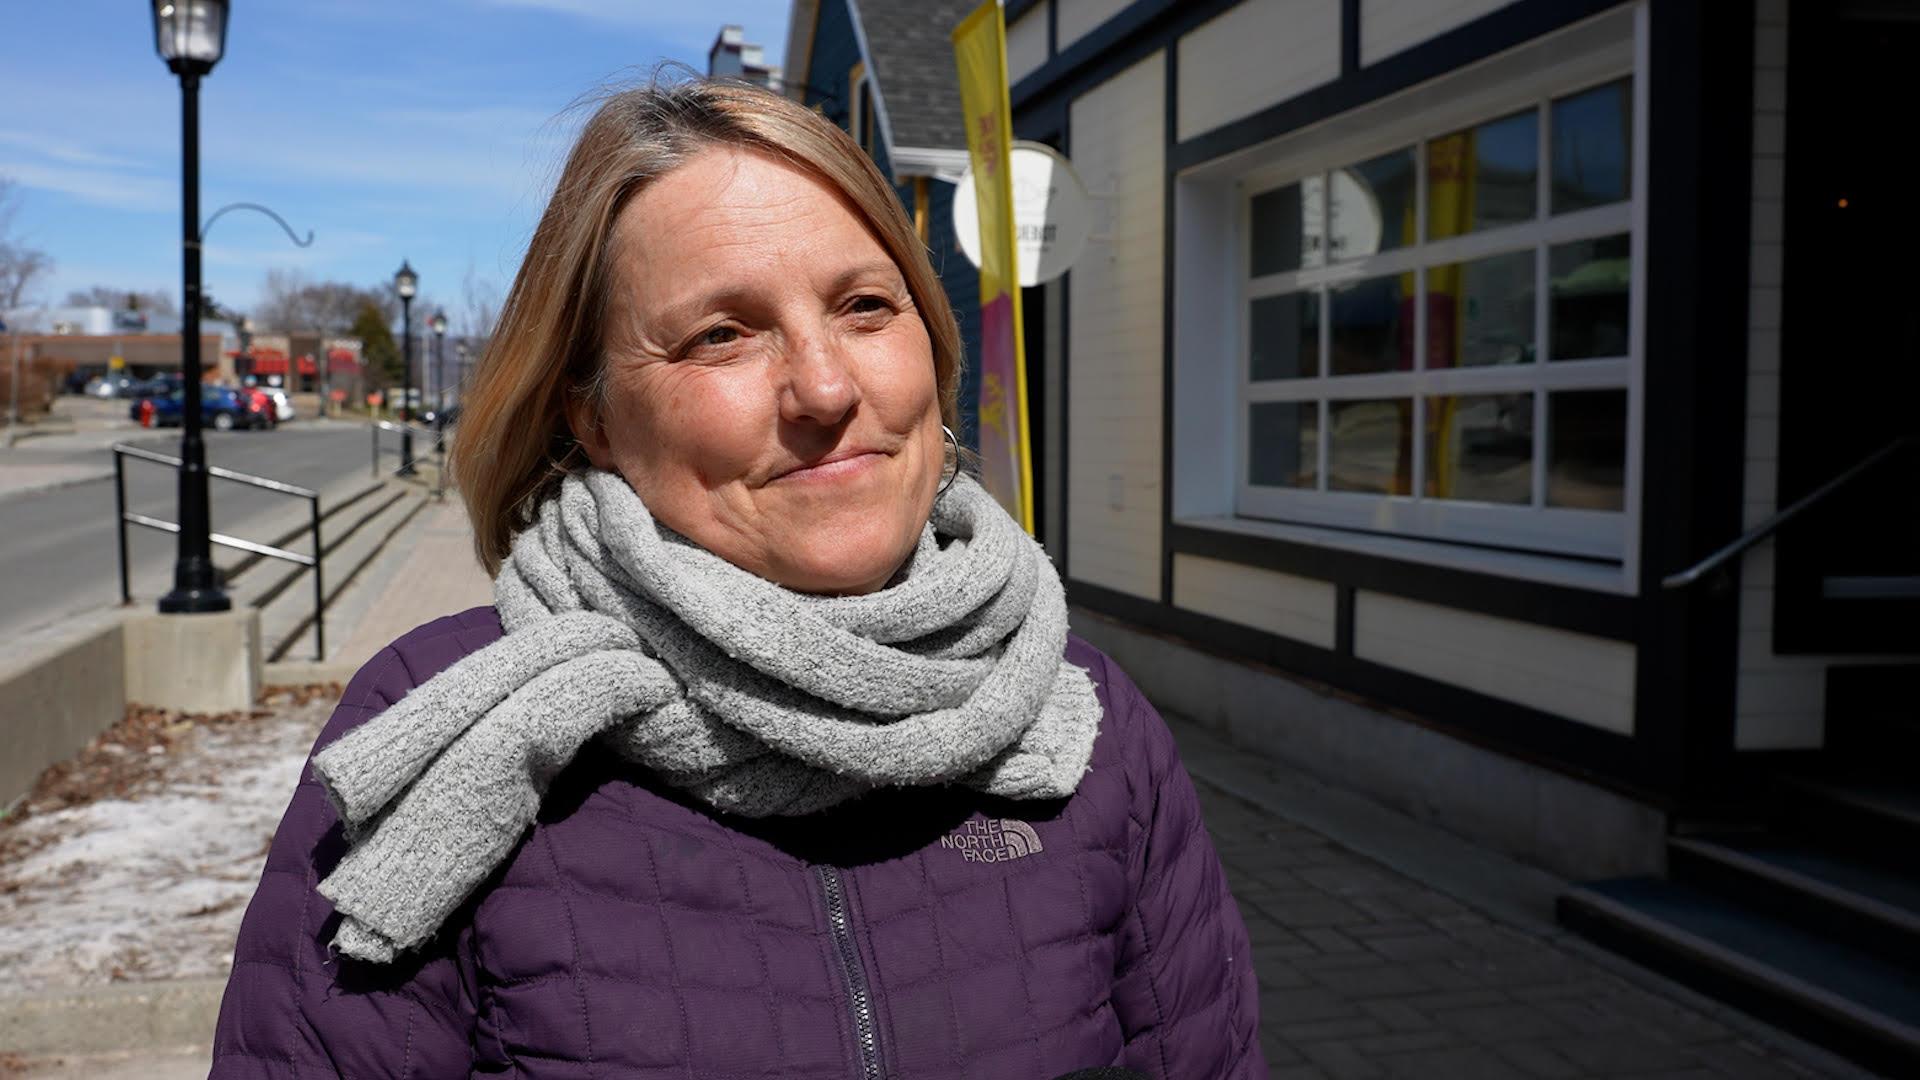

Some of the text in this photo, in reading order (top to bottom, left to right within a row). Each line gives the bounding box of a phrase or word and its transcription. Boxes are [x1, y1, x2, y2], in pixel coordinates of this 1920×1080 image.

[964, 819, 1000, 834] THE
[940, 833, 1004, 849] NORTH
[962, 847, 1009, 863] FACE
